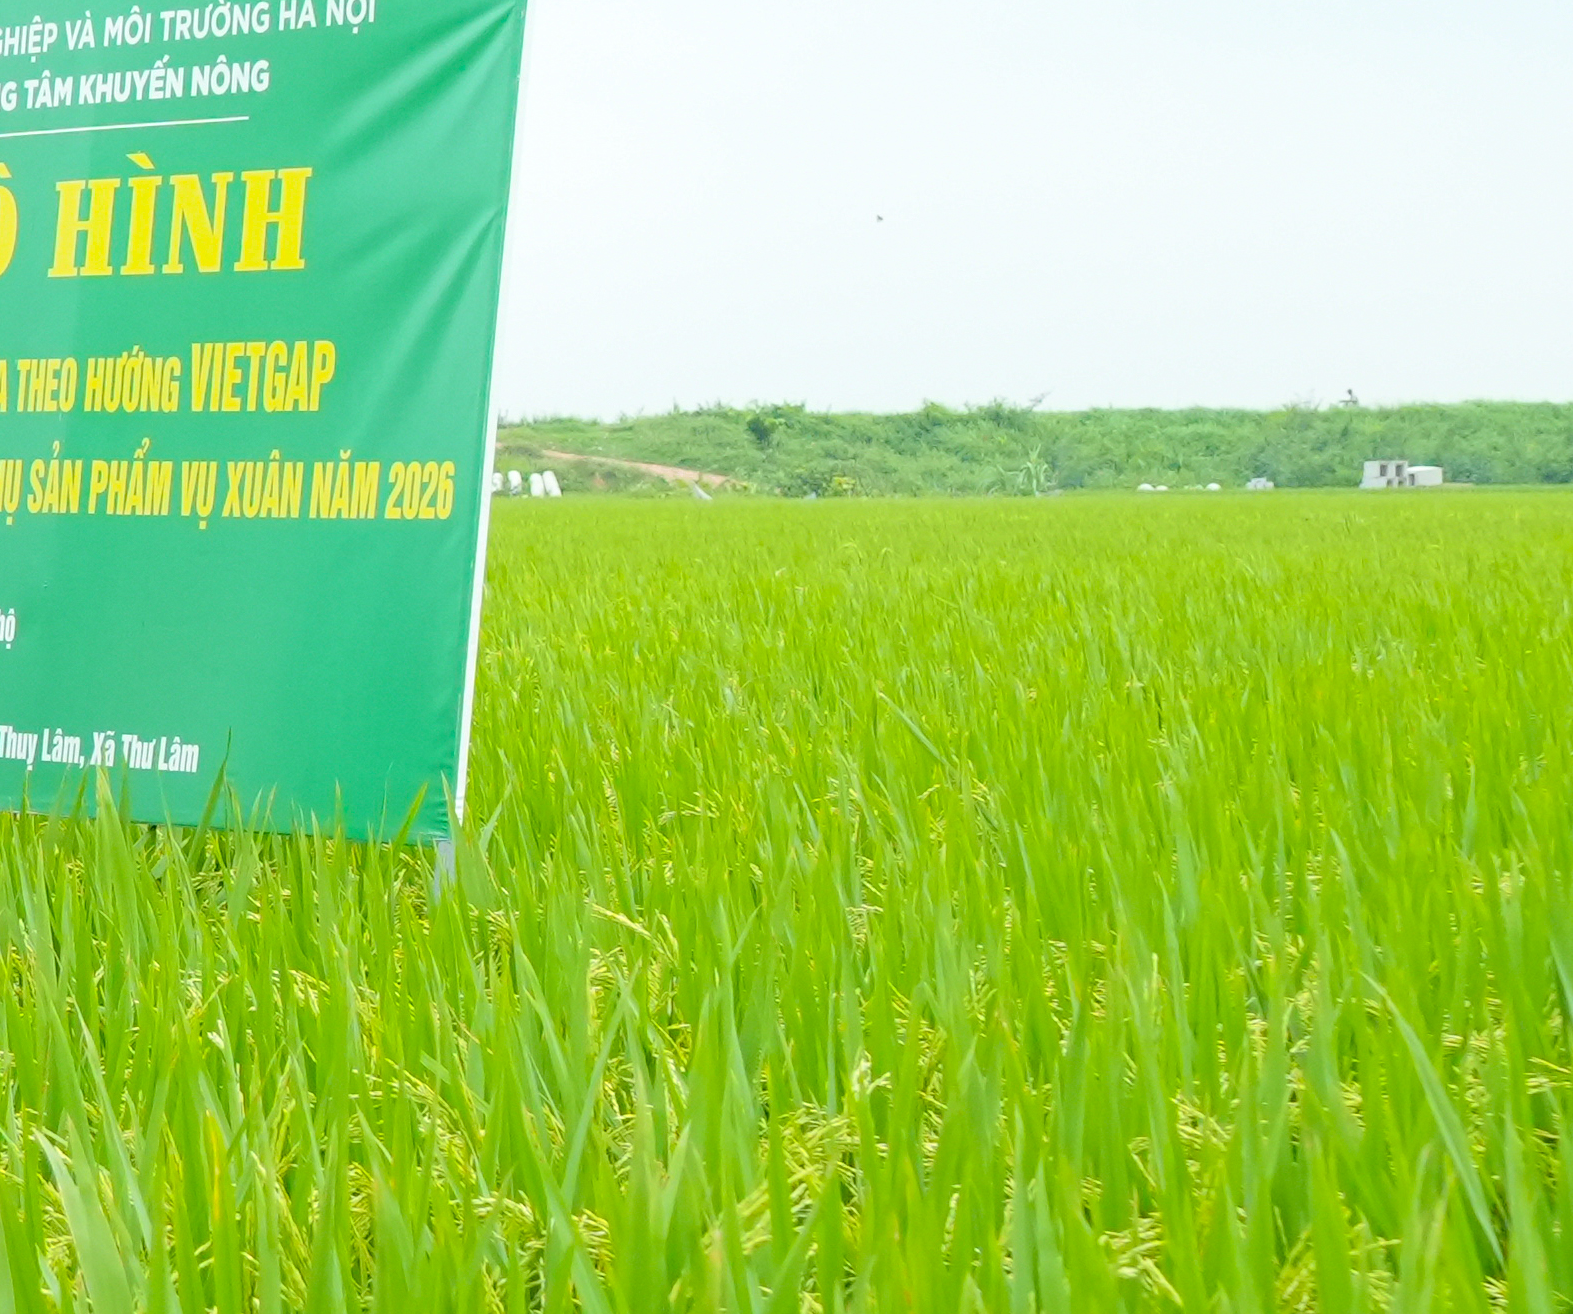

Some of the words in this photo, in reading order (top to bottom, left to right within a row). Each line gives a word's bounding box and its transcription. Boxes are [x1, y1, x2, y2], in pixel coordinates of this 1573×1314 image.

[66, 11, 95, 50] VÀ
[104, 5, 151, 47] MÔI
[24, 70, 73, 109] TÂM
[78, 55, 183, 105] KHUYẾN
[191, 55, 269, 96] NÔNG
[48, 152, 312, 277] HÌNH
[17, 357, 77, 412] THEO
[84, 346, 181, 412] HƯỚNG
[192, 340, 335, 412] VIETGAP
[27, 441, 82, 513] SẢN
[88, 438, 173, 515] PHẨM
[181, 461, 217, 529] VỤ
[222, 450, 303, 518] XUÂN
[309, 450, 381, 519] NĂM
[385, 461, 455, 519] 2026
[42, 729, 84, 768] Lâm,
[90, 730, 116, 768] Xã
[122, 735, 156, 769] Thư
[158, 737, 199, 772] Lâm
